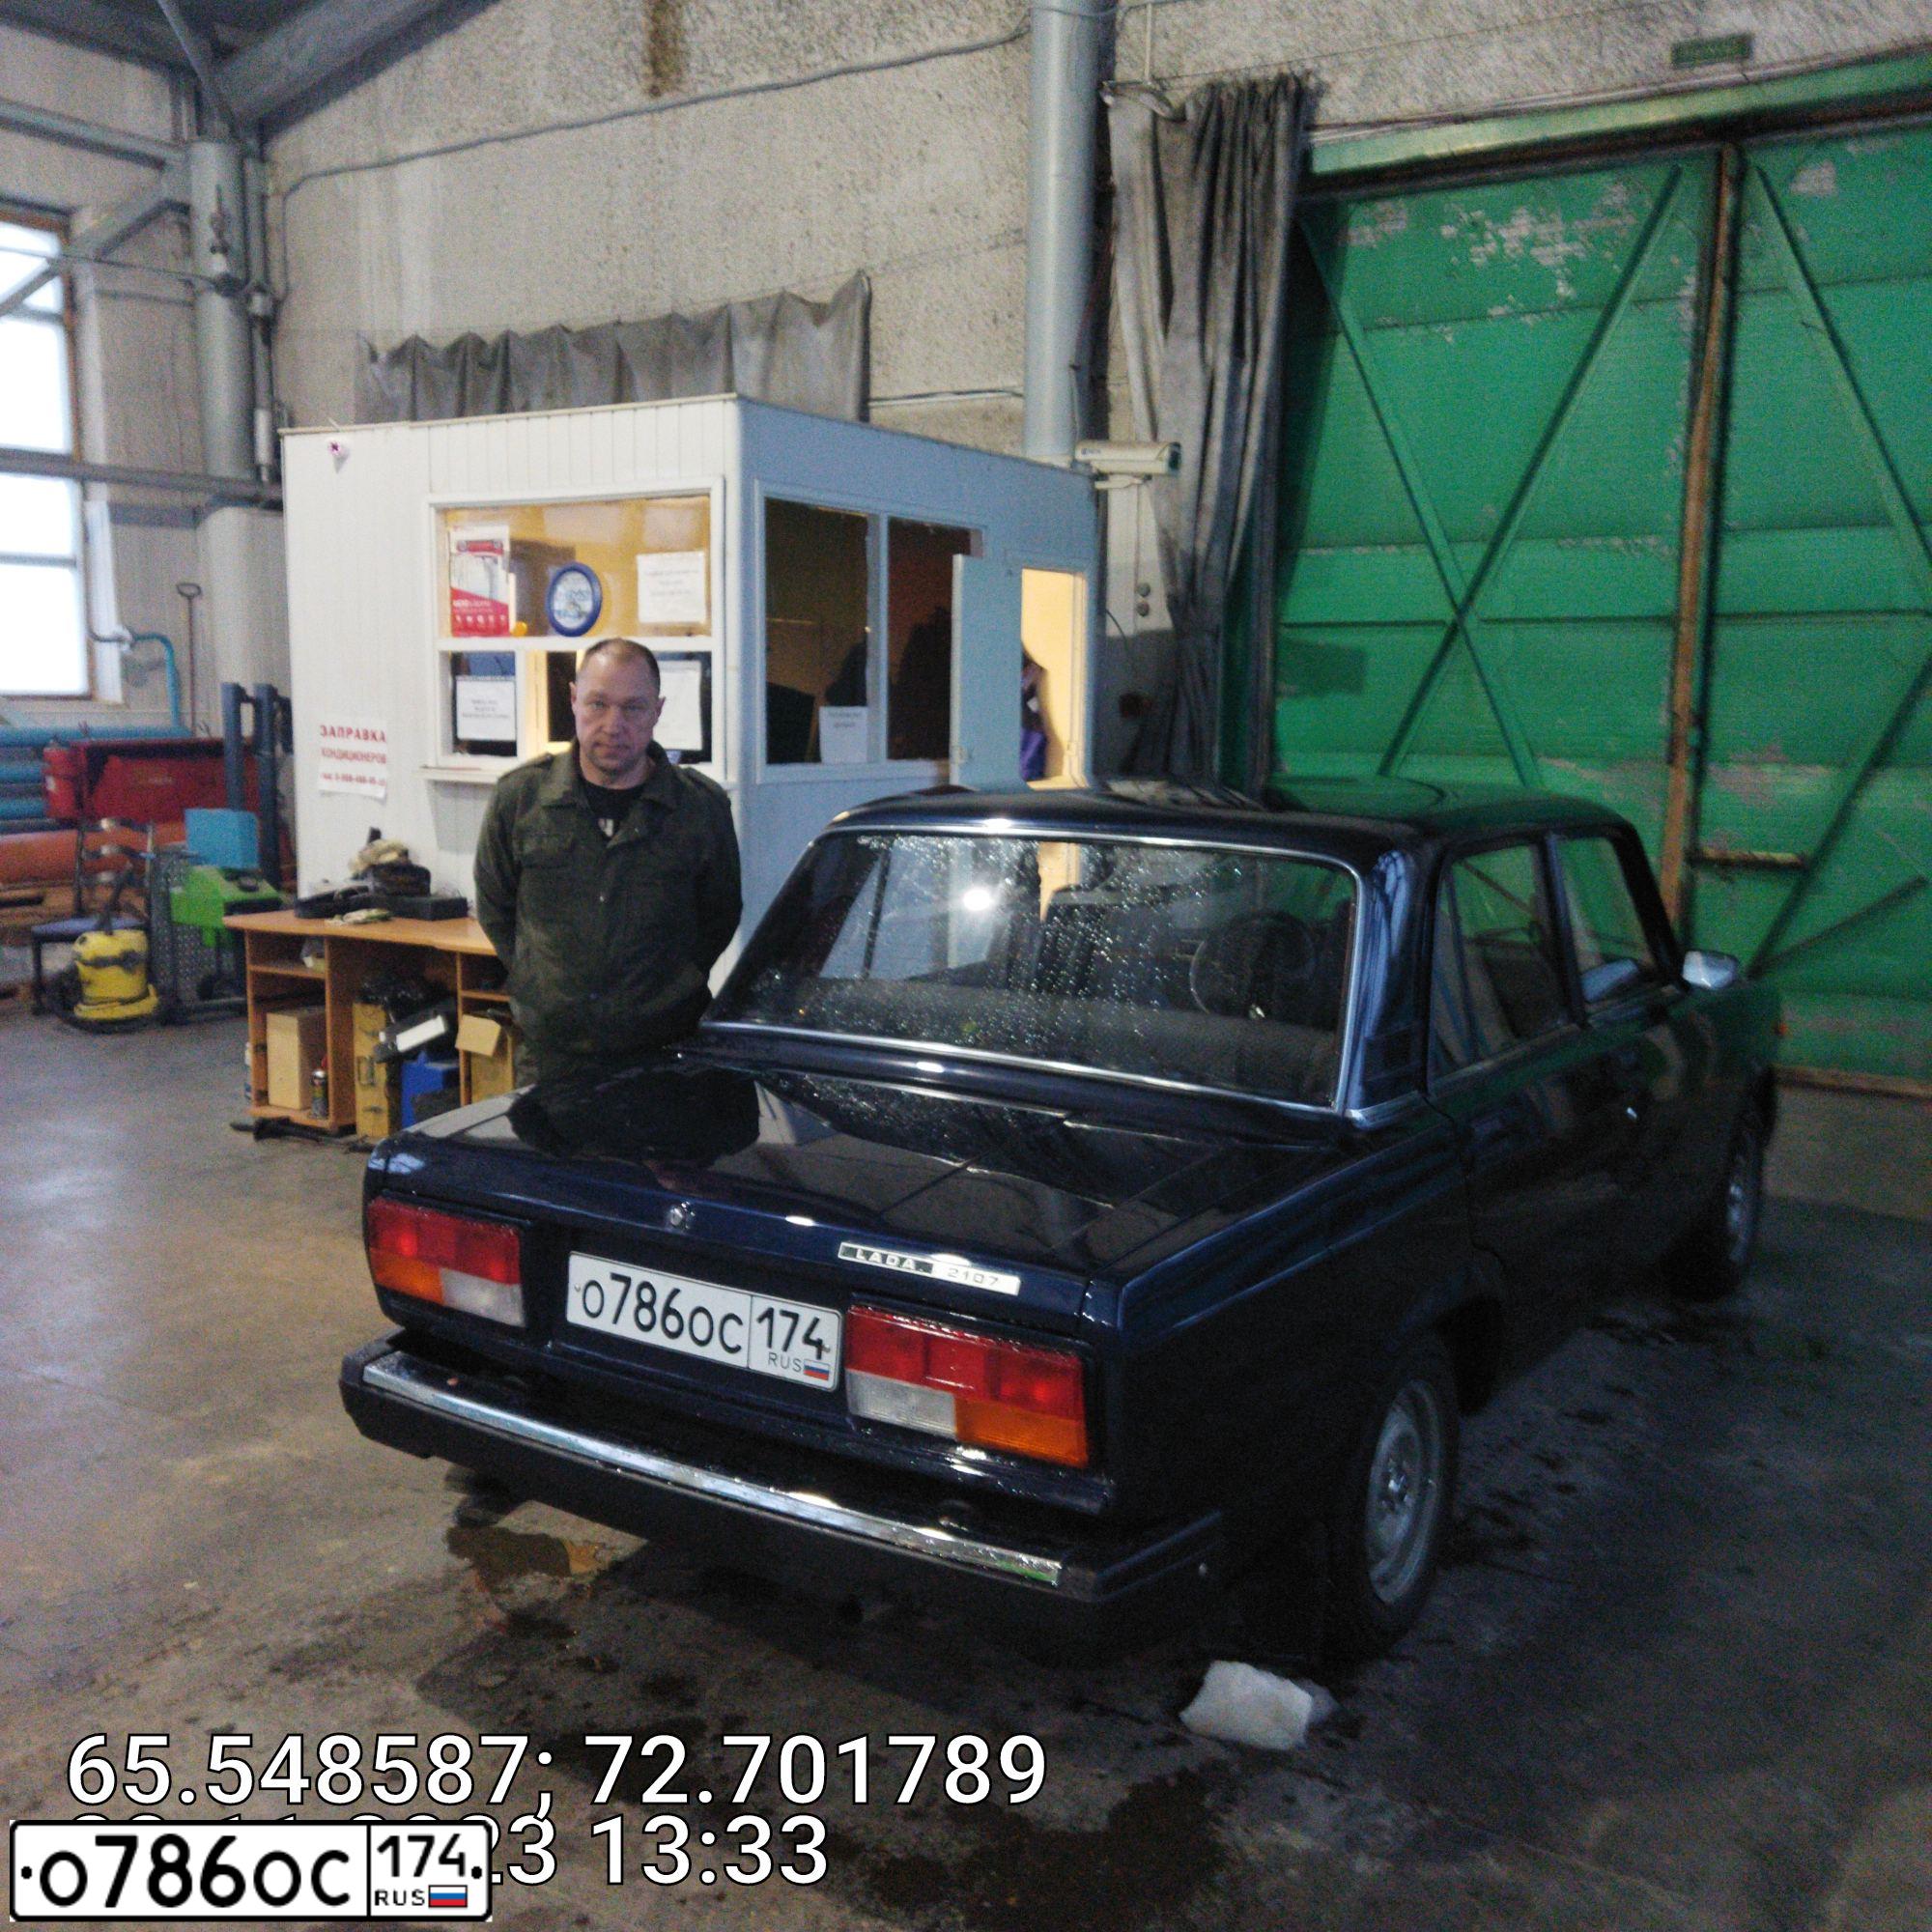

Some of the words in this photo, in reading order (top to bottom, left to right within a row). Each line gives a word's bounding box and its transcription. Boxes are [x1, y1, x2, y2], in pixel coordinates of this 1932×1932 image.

[320, 724, 386, 743] ЗАПРАВКА
[856, 1248, 916, 1271] LADA
[947, 1266, 1000, 1287] 2107
[756, 1307, 823, 1360] 174
[768, 1352, 801, 1373] RUS
